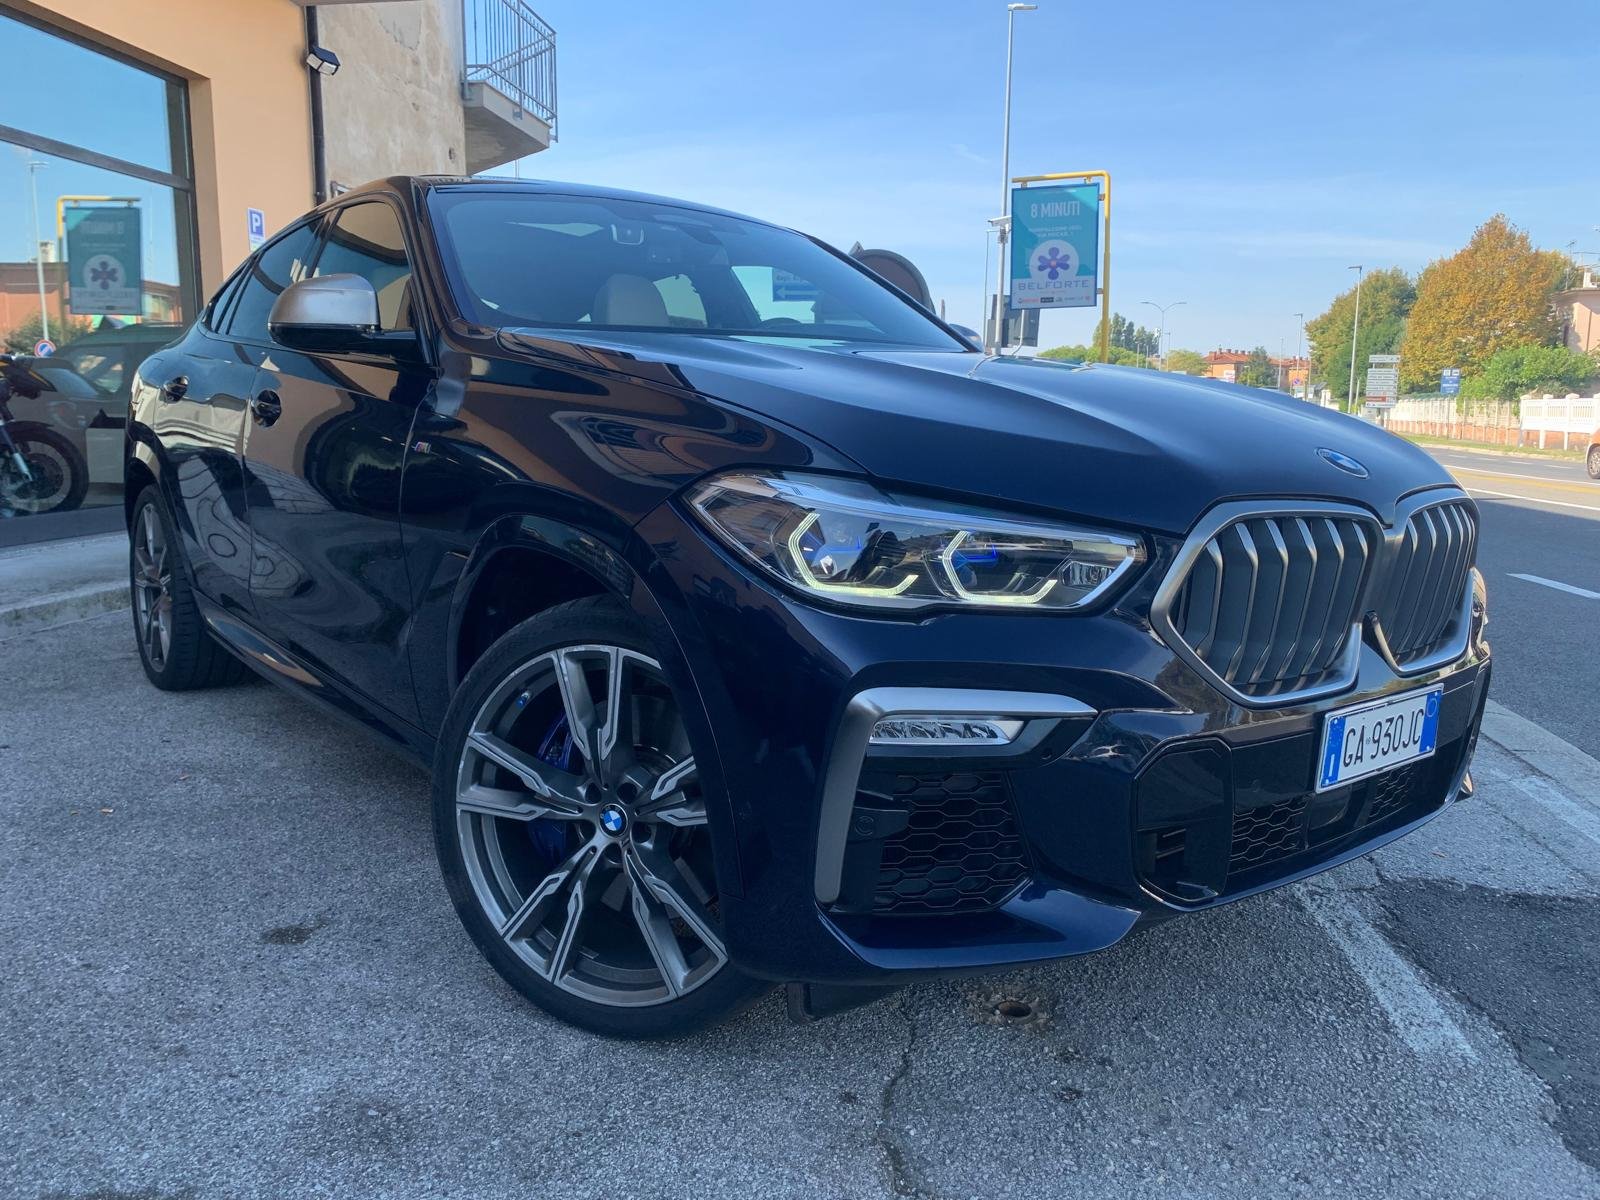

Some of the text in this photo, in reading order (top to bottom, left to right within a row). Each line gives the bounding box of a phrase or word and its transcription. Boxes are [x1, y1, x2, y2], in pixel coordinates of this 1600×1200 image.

[1031, 201, 1079, 218] 8 MINUTI
[252, 213, 261, 233] P
[1018, 279, 1089, 291] BELFORTE
[1343, 708, 1424, 767] GA 930JC
